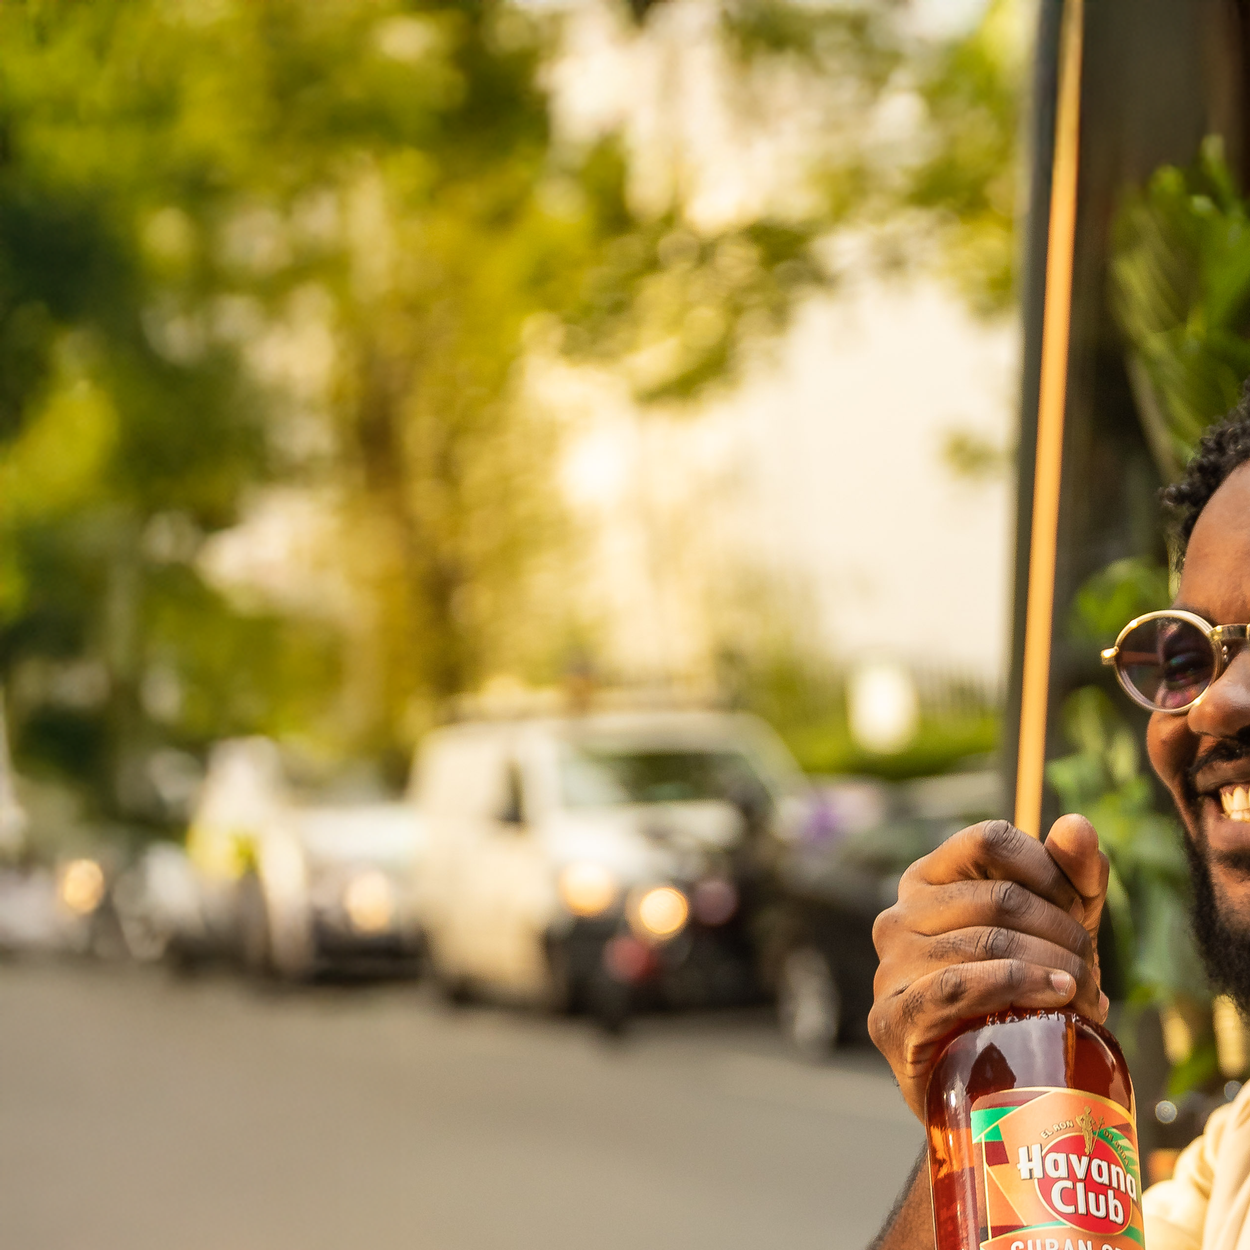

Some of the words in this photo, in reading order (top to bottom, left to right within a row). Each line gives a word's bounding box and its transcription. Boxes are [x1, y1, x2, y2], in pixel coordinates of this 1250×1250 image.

[1040, 1129, 1053, 1139] EL
[1053, 1120, 1074, 1132] RON
[1017, 1143, 1138, 1202] Havana
[1050, 1180, 1125, 1225] Club
